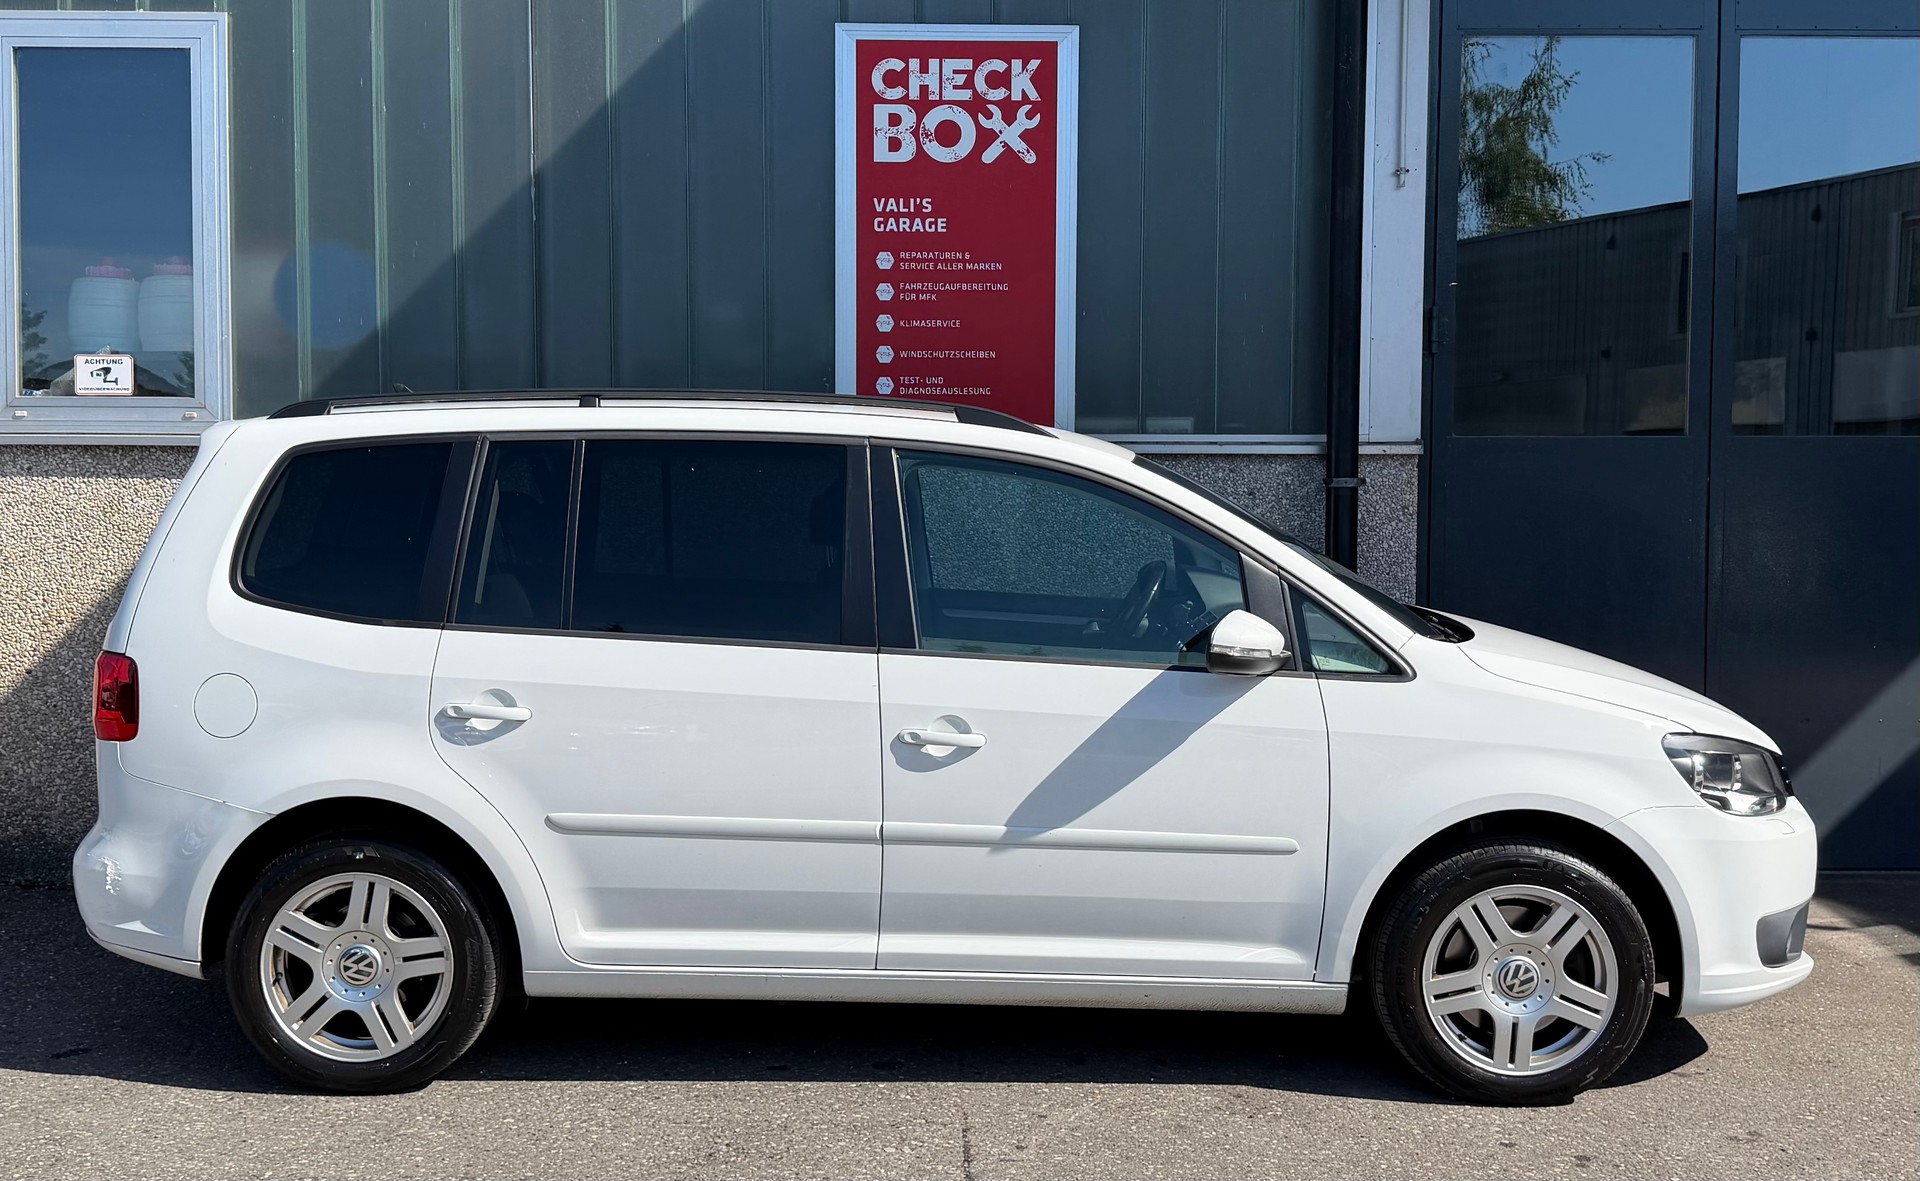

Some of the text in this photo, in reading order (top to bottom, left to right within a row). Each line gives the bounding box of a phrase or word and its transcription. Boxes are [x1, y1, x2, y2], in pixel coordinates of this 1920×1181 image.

[871, 58, 1042, 101] CHECK
[873, 104, 1041, 164] BOX
[873, 198, 932, 213] VALI'S
[873, 217, 947, 232] GARAGE
[900, 251, 971, 260] REPARATUREN &
[900, 262, 1002, 271] SERVICE ALLER MARKEN
[900, 282, 1009, 291] FAHRZEUGAUFBEREITUNG
[900, 292, 937, 301] FÜR MFK
[899, 319, 961, 328] KLIMASERVICE
[899, 350, 996, 359] WINDSCHUTZSCHEIBEN
[899, 376, 944, 384] TEST- UND
[899, 387, 991, 395] DIAGNOSEAUSLESUNG
[1499, 960, 1538, 998] VW
